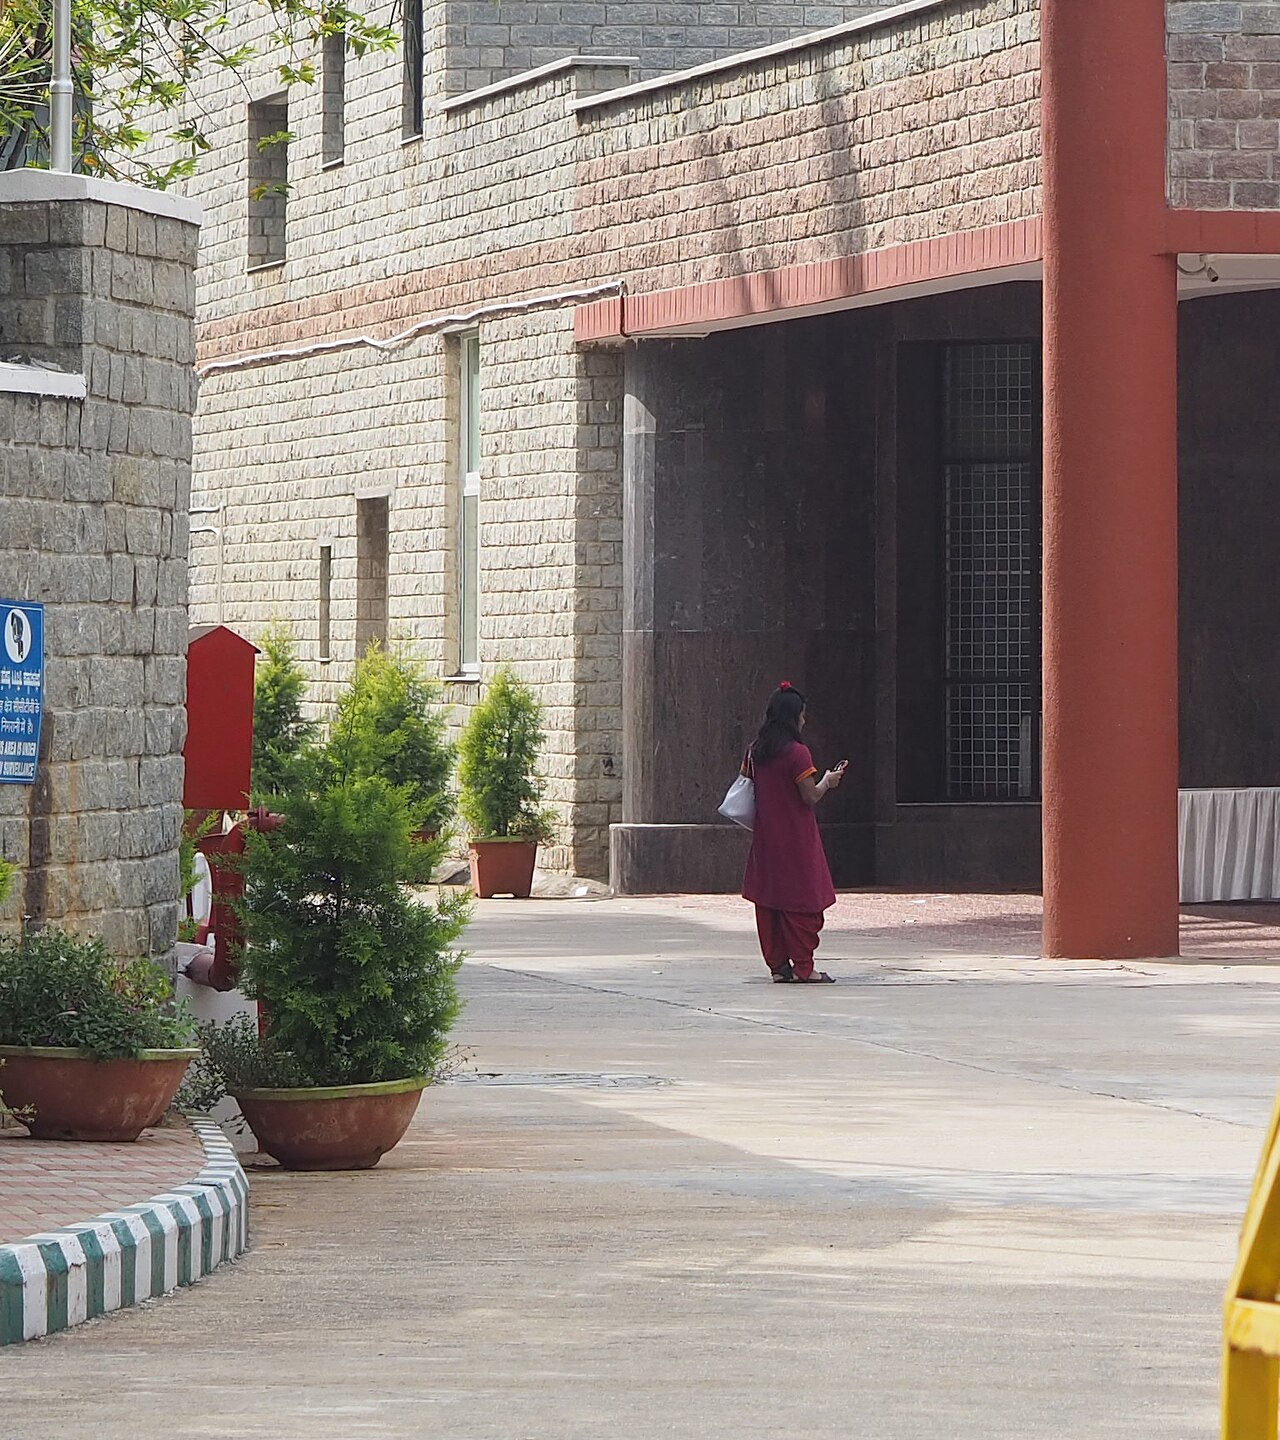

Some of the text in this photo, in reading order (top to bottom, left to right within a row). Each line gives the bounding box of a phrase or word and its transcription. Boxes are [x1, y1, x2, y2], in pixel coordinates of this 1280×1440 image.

[4, 741, 16, 755] AREA
[17, 741, 22, 756] IS
[22, 742, 37, 756] UNDER
[3, 761, 35, 776] SURVEILLANCE
